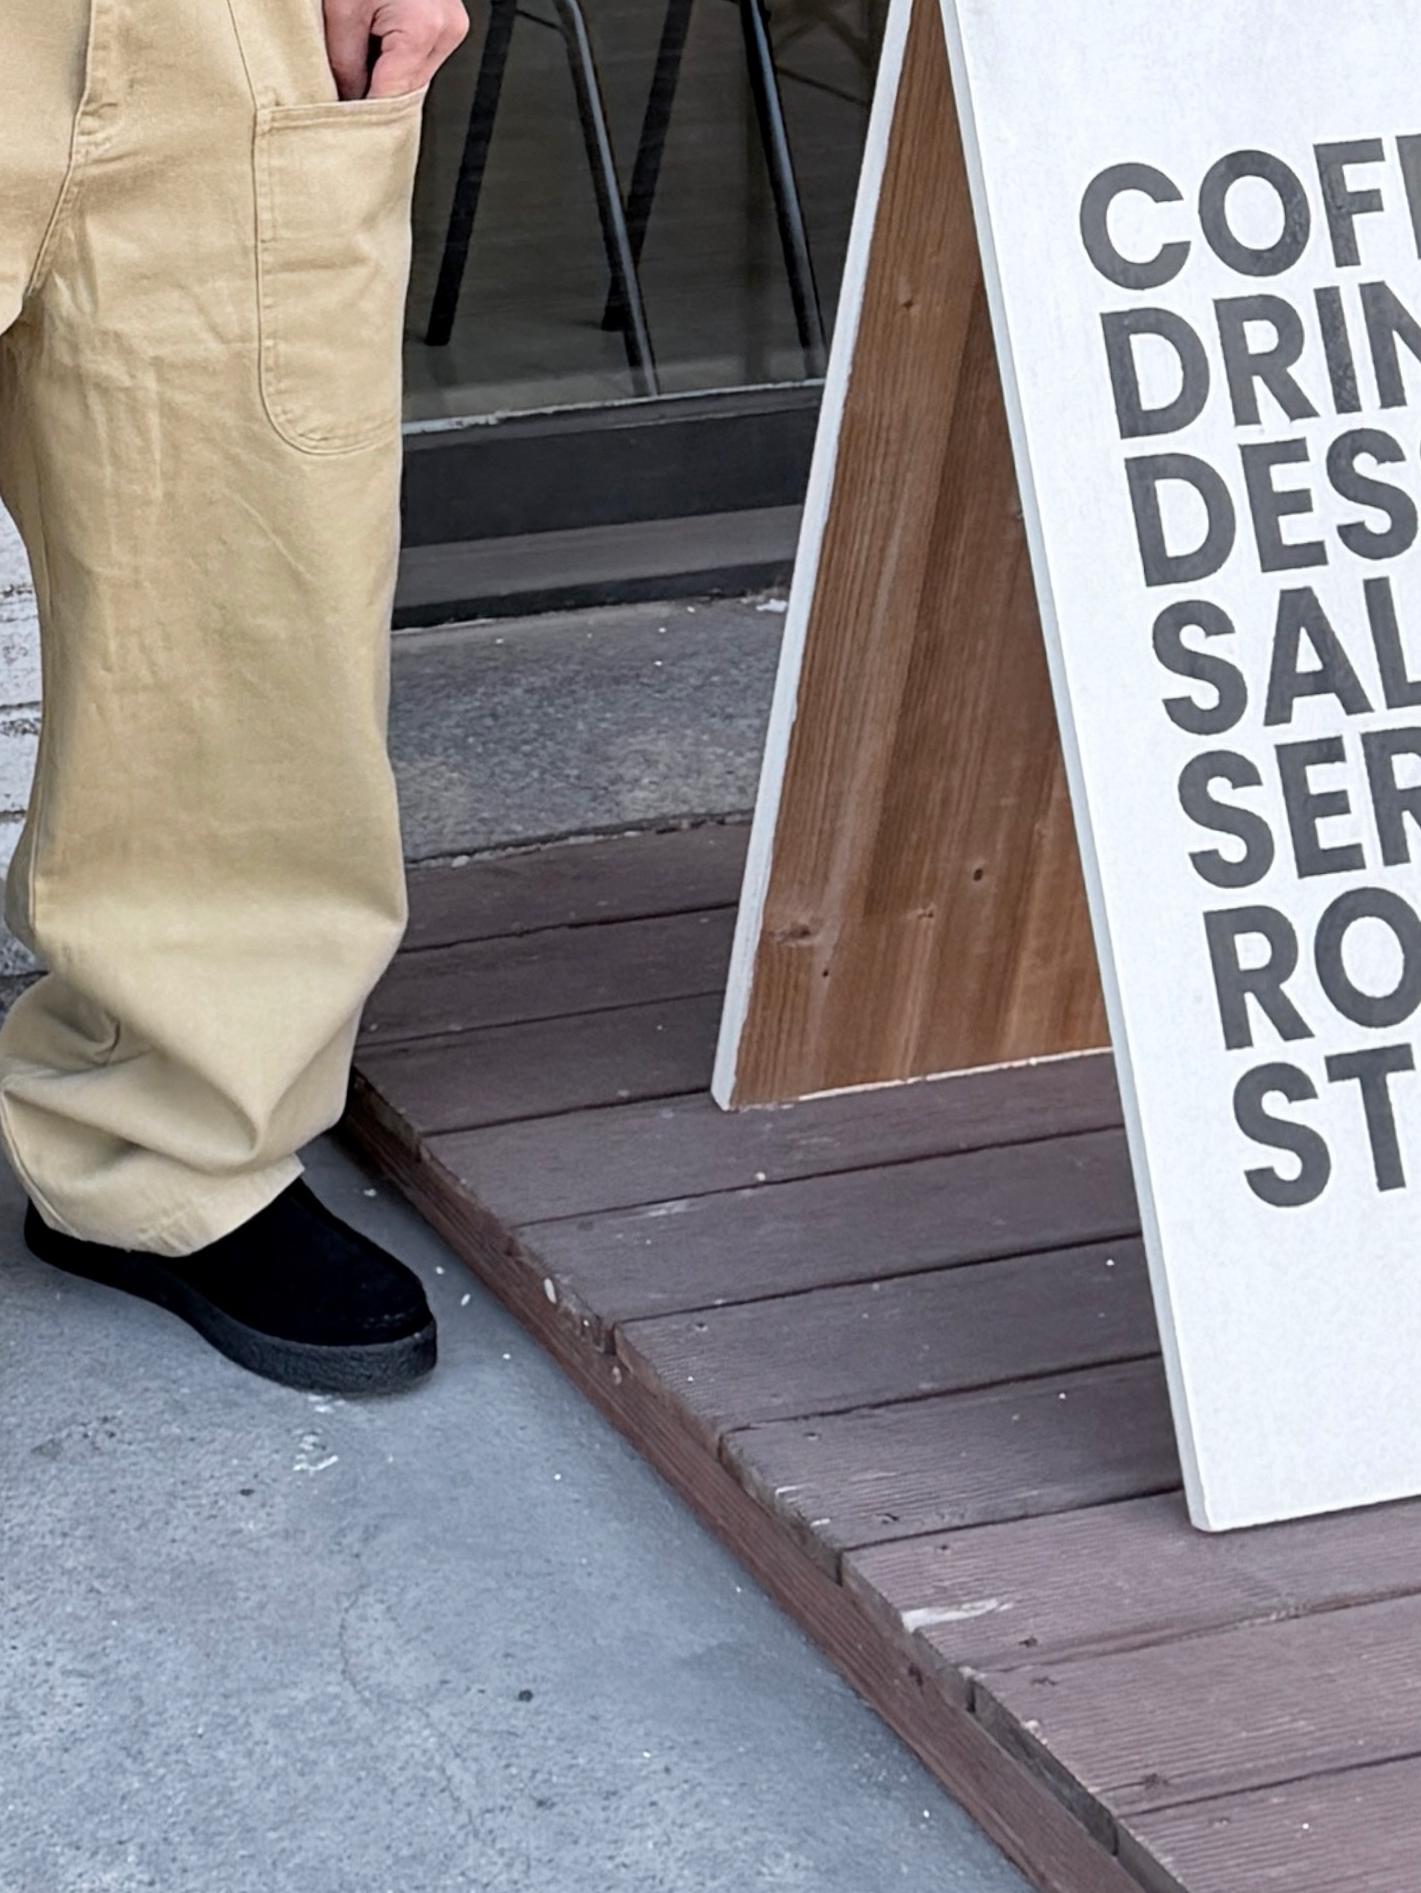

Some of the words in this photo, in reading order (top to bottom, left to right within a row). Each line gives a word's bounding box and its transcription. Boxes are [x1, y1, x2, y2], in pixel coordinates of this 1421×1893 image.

[1152, 576, 1421, 735] SAL
[1204, 886, 1421, 1051] RO
[1233, 1043, 1415, 1208] ST
